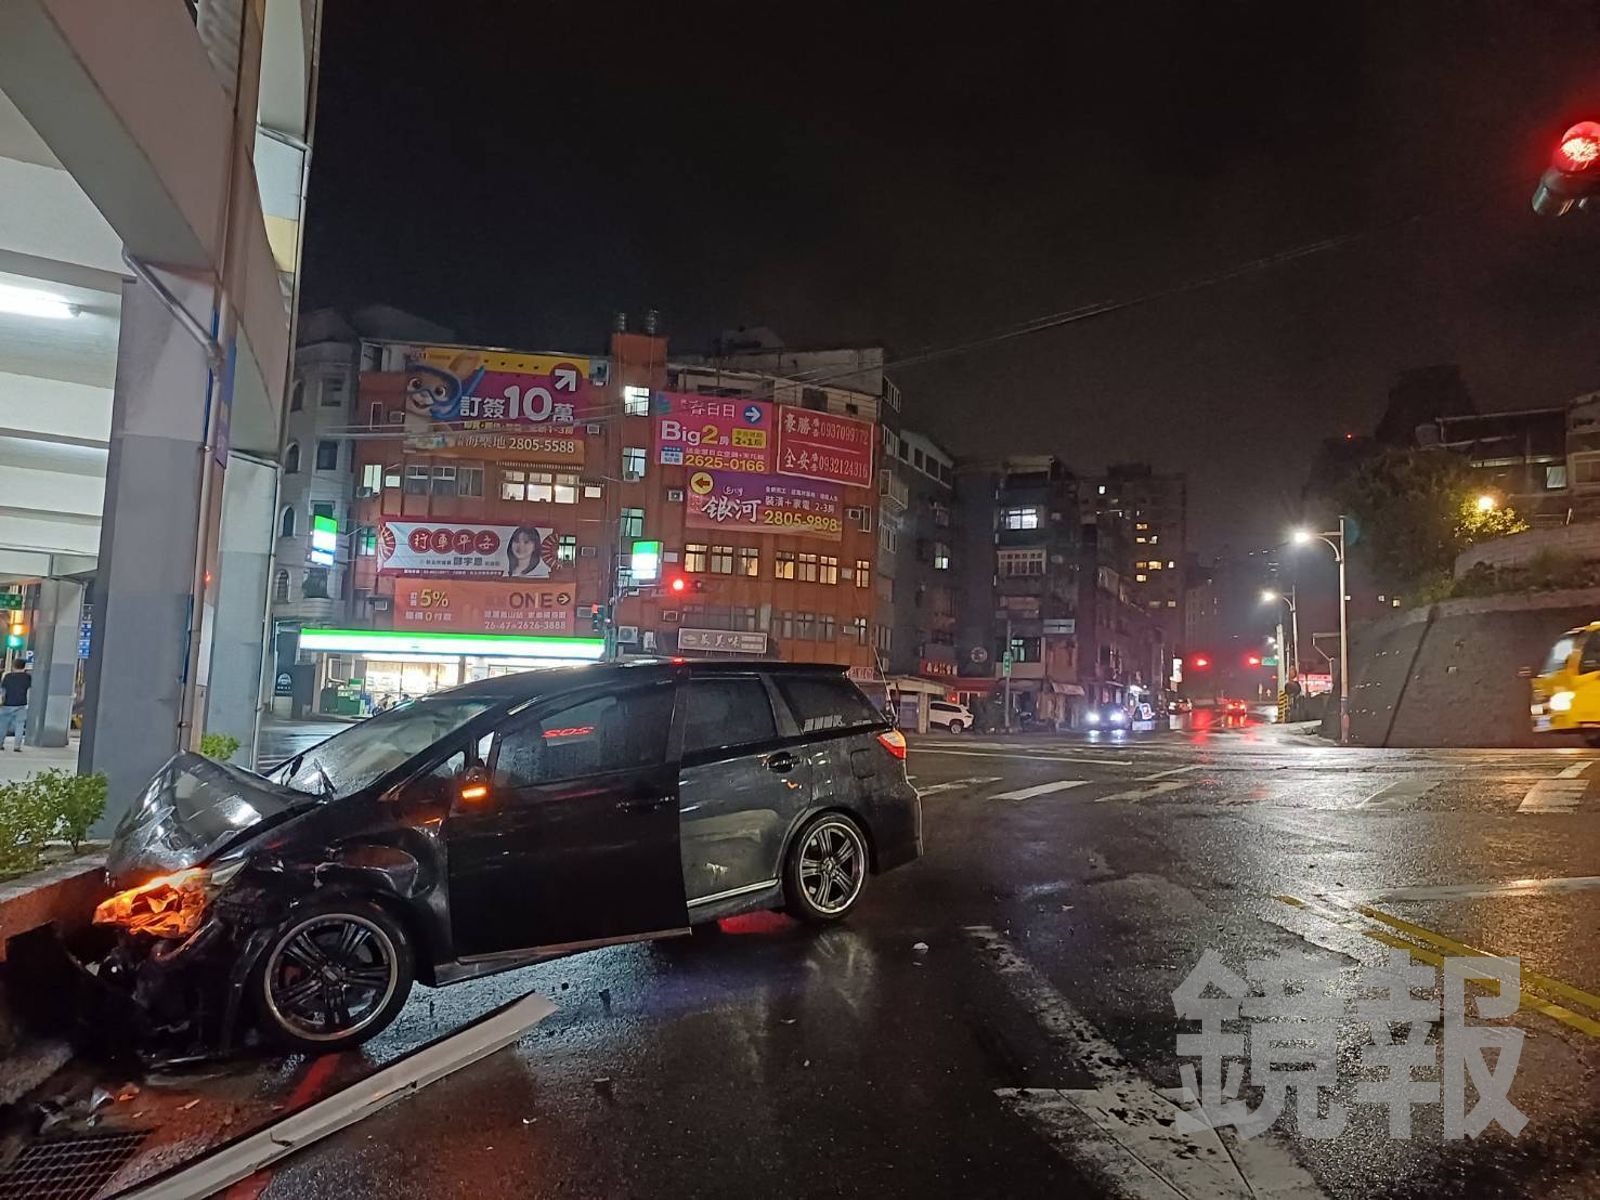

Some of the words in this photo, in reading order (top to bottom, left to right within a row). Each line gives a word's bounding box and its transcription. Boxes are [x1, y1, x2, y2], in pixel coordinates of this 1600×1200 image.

[508, 437, 575, 454] 2805-5588
[684, 454, 766, 473] 2625-0166
[784, 447, 810, 470] 全安
[702, 494, 762, 523] 銀河
[763, 509, 839, 532] 2805-9898
[420, 588, 450, 608] 5%
[509, 592, 553, 609] ONE
